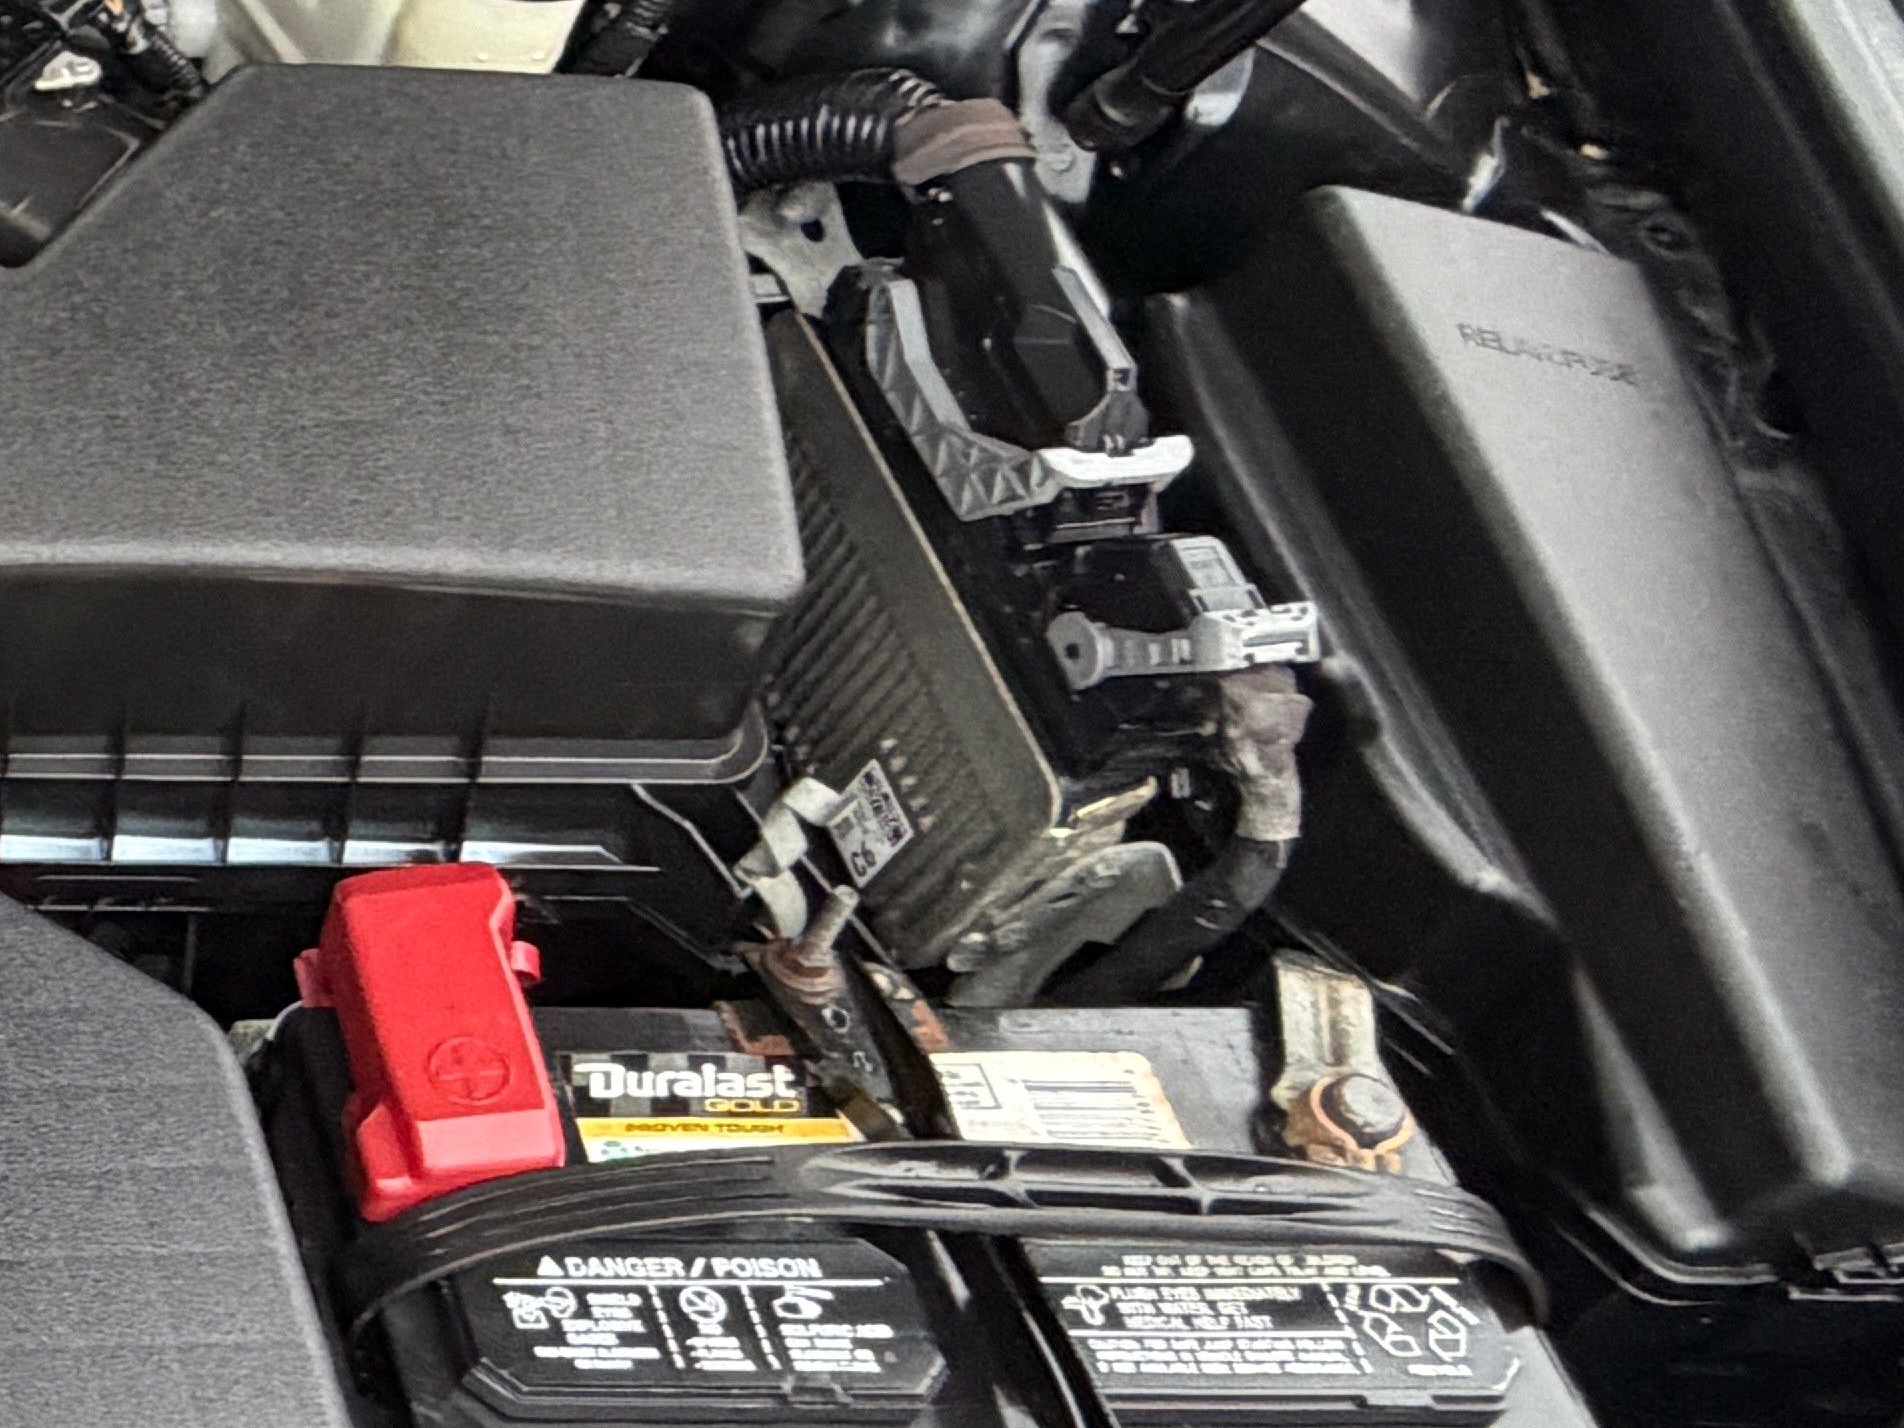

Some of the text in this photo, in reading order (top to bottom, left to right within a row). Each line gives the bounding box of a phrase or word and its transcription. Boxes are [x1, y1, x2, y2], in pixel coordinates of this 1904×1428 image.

[574, 1062, 797, 1098] Duralast
[704, 1098, 800, 1112] GOLD
[625, 1122, 784, 1133] PROVEN TOUGH
[563, 1256, 685, 1278] DANGER
[712, 1257, 823, 1279] POISON
